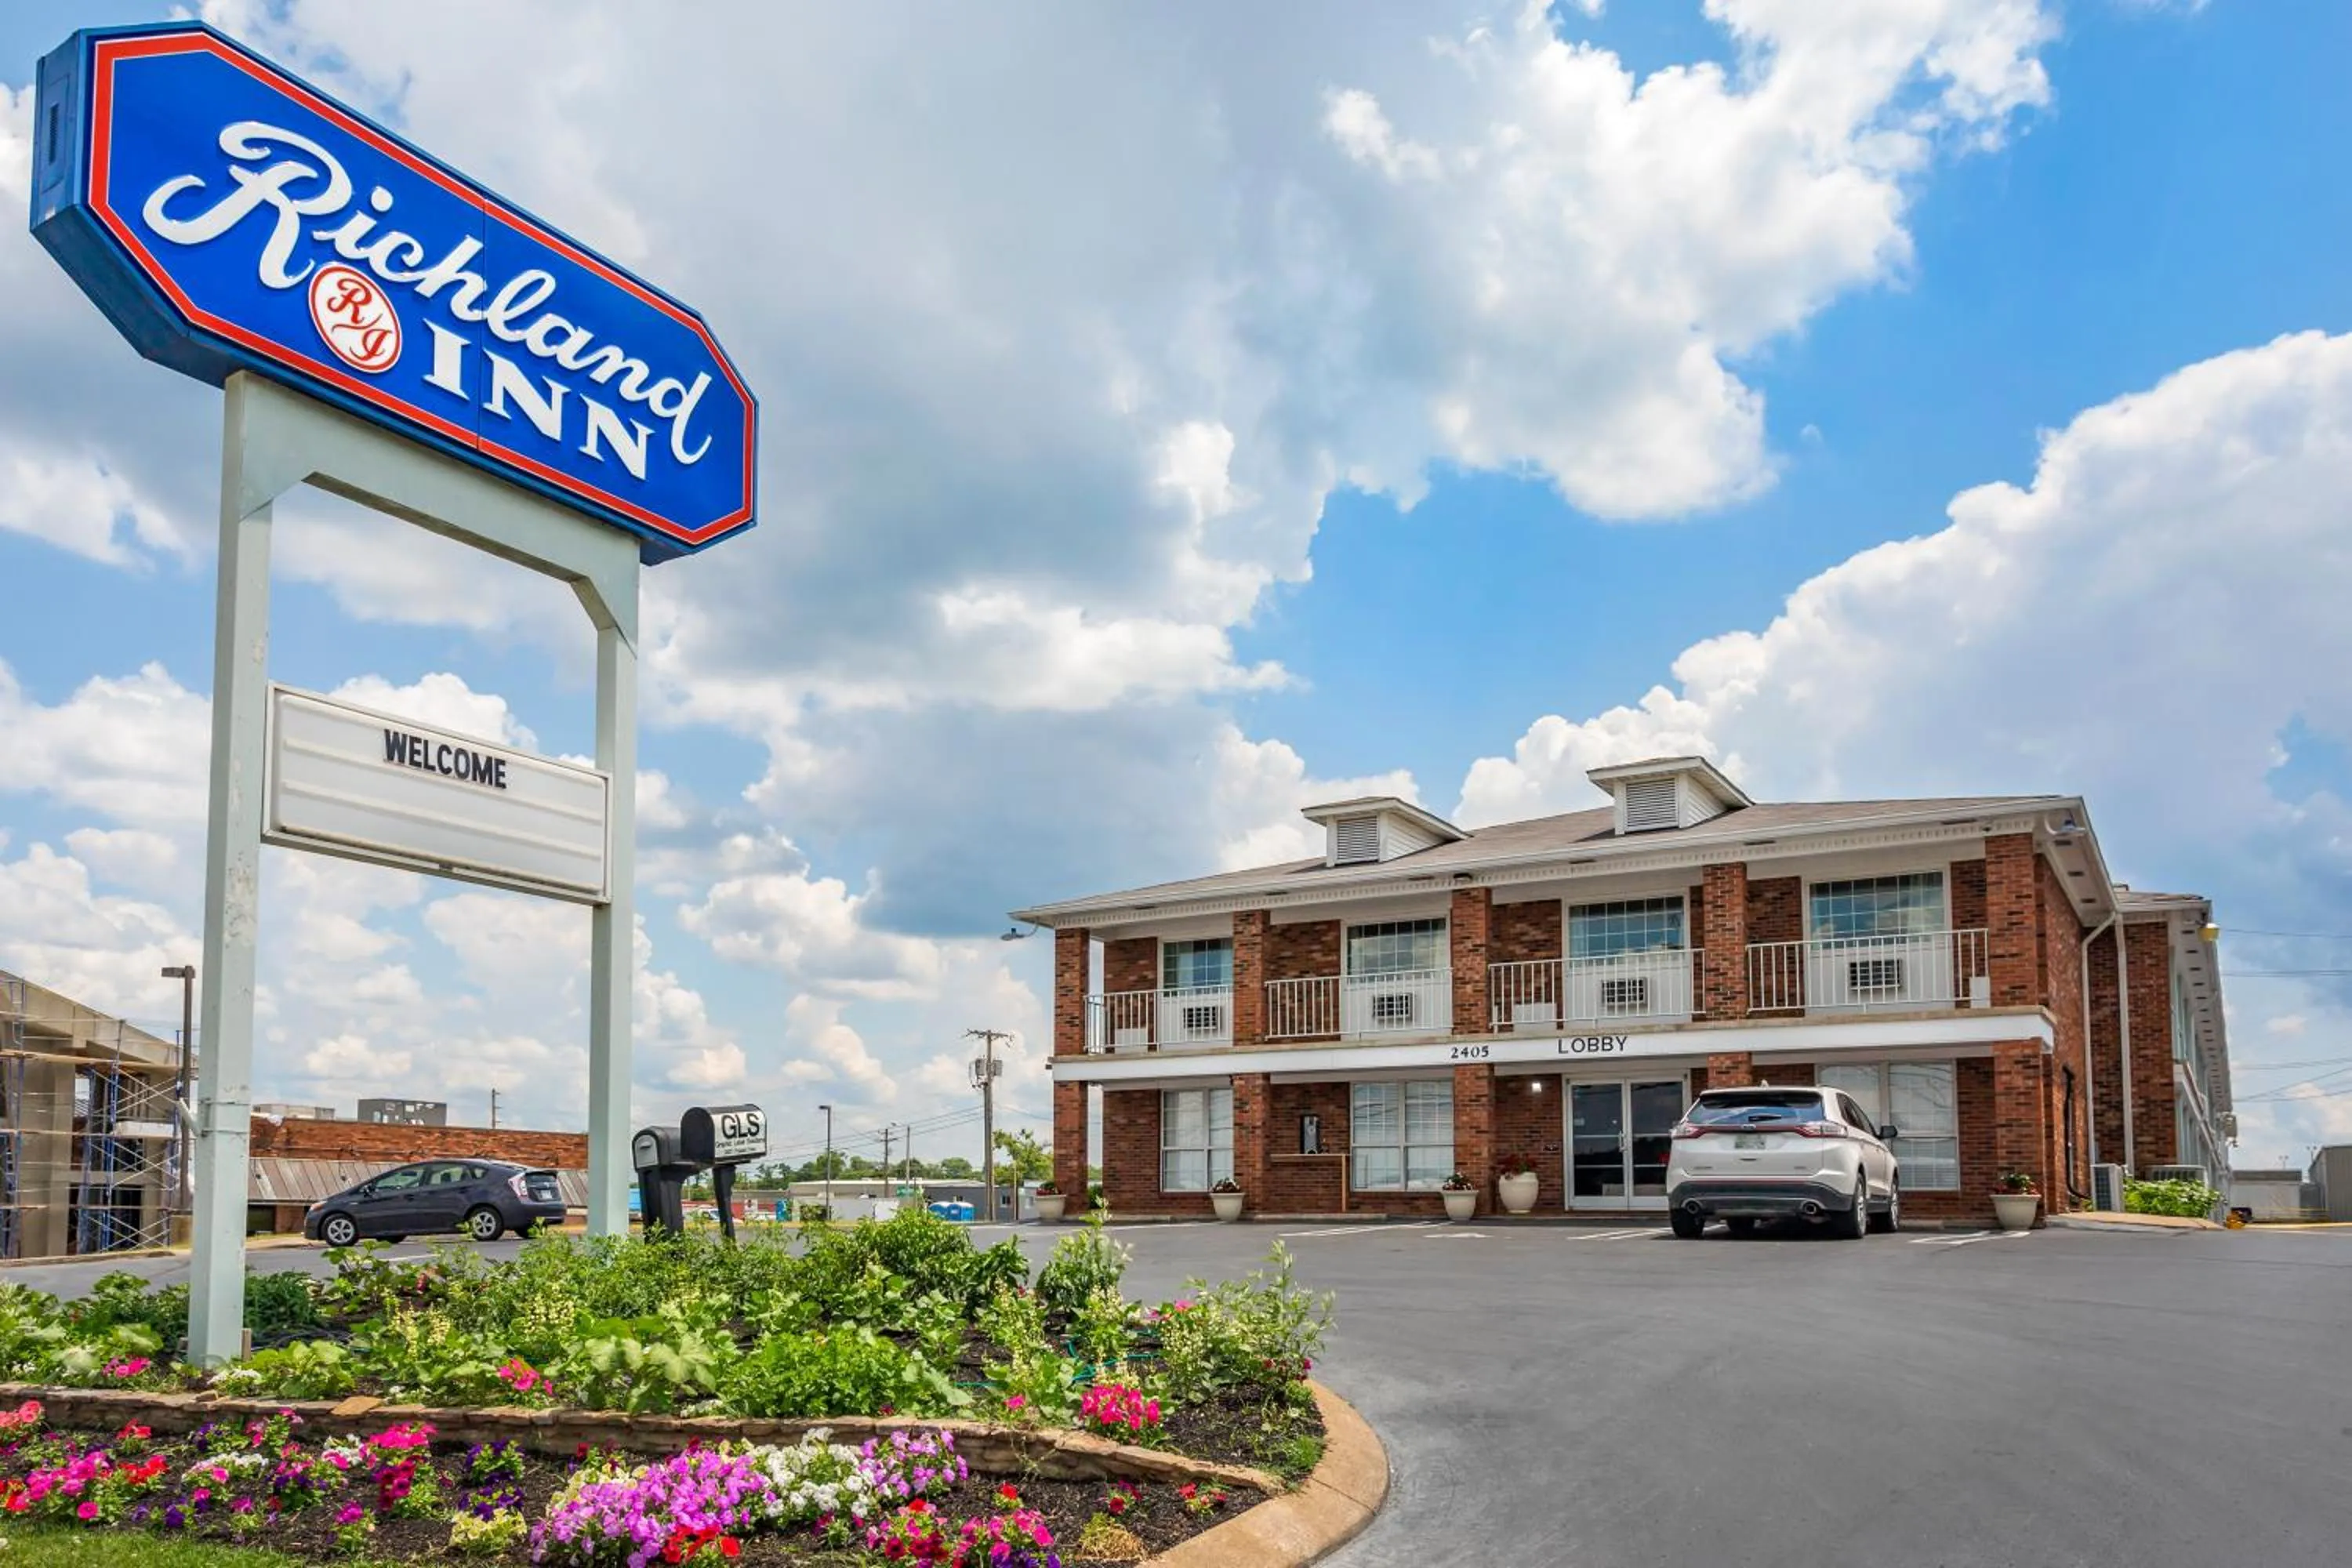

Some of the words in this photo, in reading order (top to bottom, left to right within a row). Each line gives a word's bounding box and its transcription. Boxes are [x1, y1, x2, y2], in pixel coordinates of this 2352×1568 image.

[143, 121, 712, 464] Richland
[423, 319, 655, 480] INN
[384, 729, 506, 789] WELCOME
[1451, 1046, 1490, 1058] 2405
[1558, 1036, 1627, 1054] LOBBY
[721, 1113, 760, 1139] GLS
